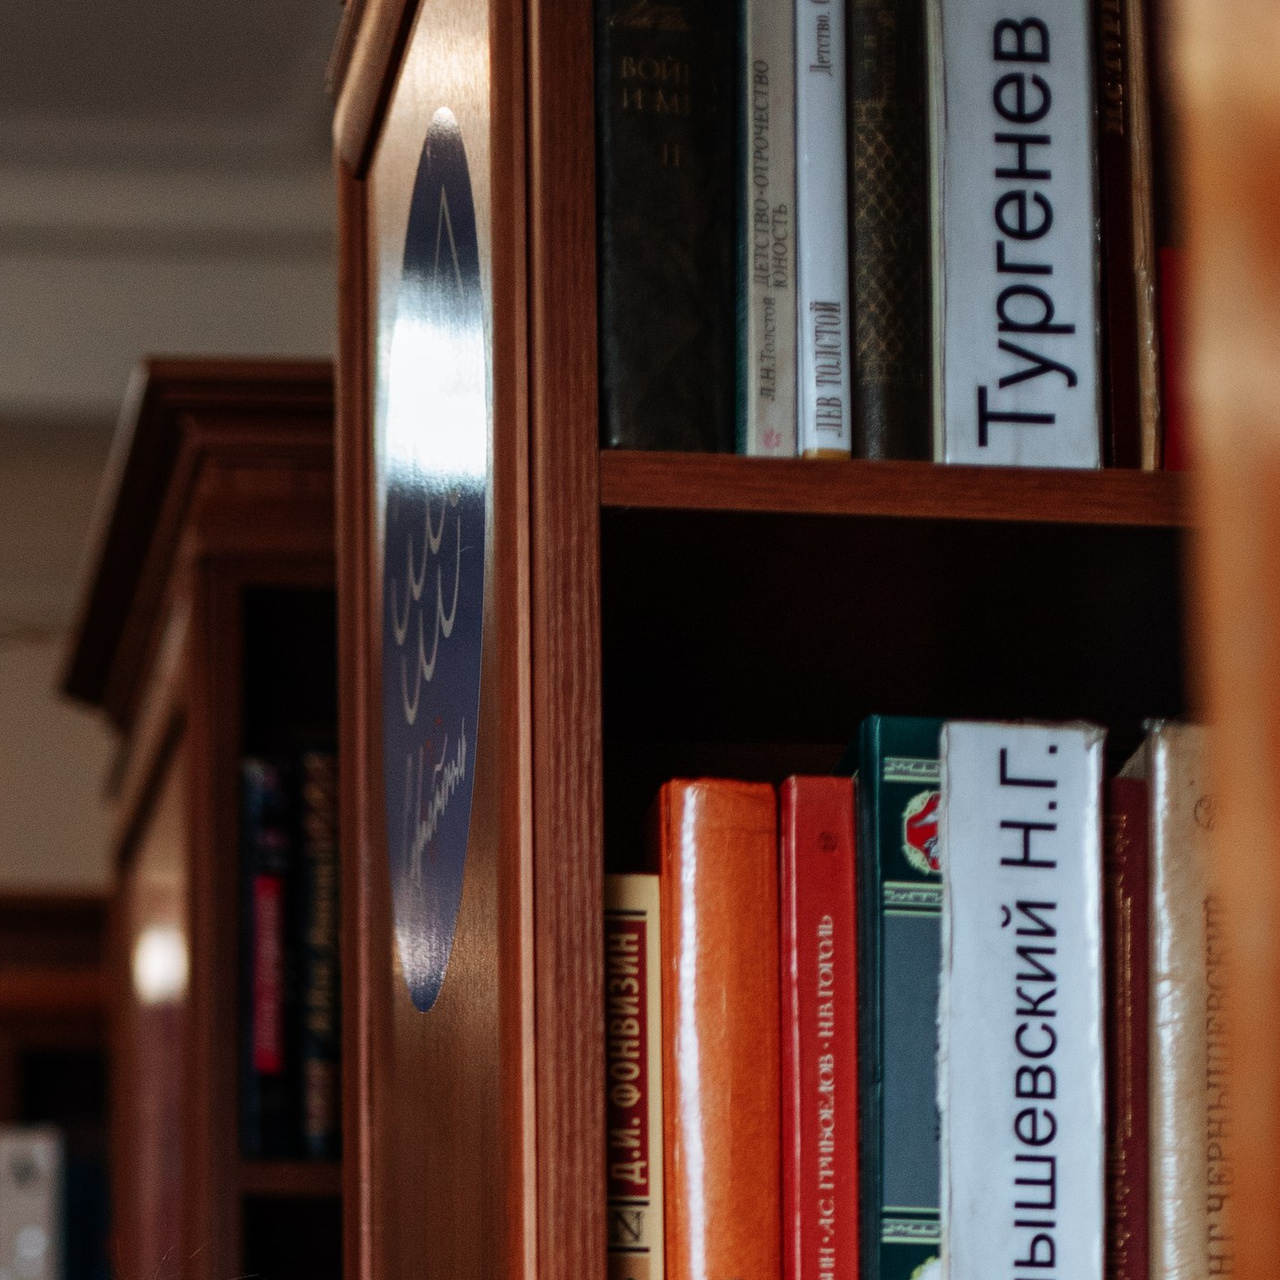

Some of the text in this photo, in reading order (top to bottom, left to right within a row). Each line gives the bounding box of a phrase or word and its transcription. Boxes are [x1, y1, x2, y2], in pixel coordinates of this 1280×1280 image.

[773, 203, 788, 288] ЮНОСТЬ
[976, 15, 1078, 447] Тургенев
[810, 301, 842, 388] ТОЛСТОЙ
[816, 395, 843, 438] ЛЕВ
[998, 744, 1061, 869] Н.Г.
[609, 933, 642, 1108] ФОНВИЗИН
[611, 1117, 647, 1186] Д.И.
